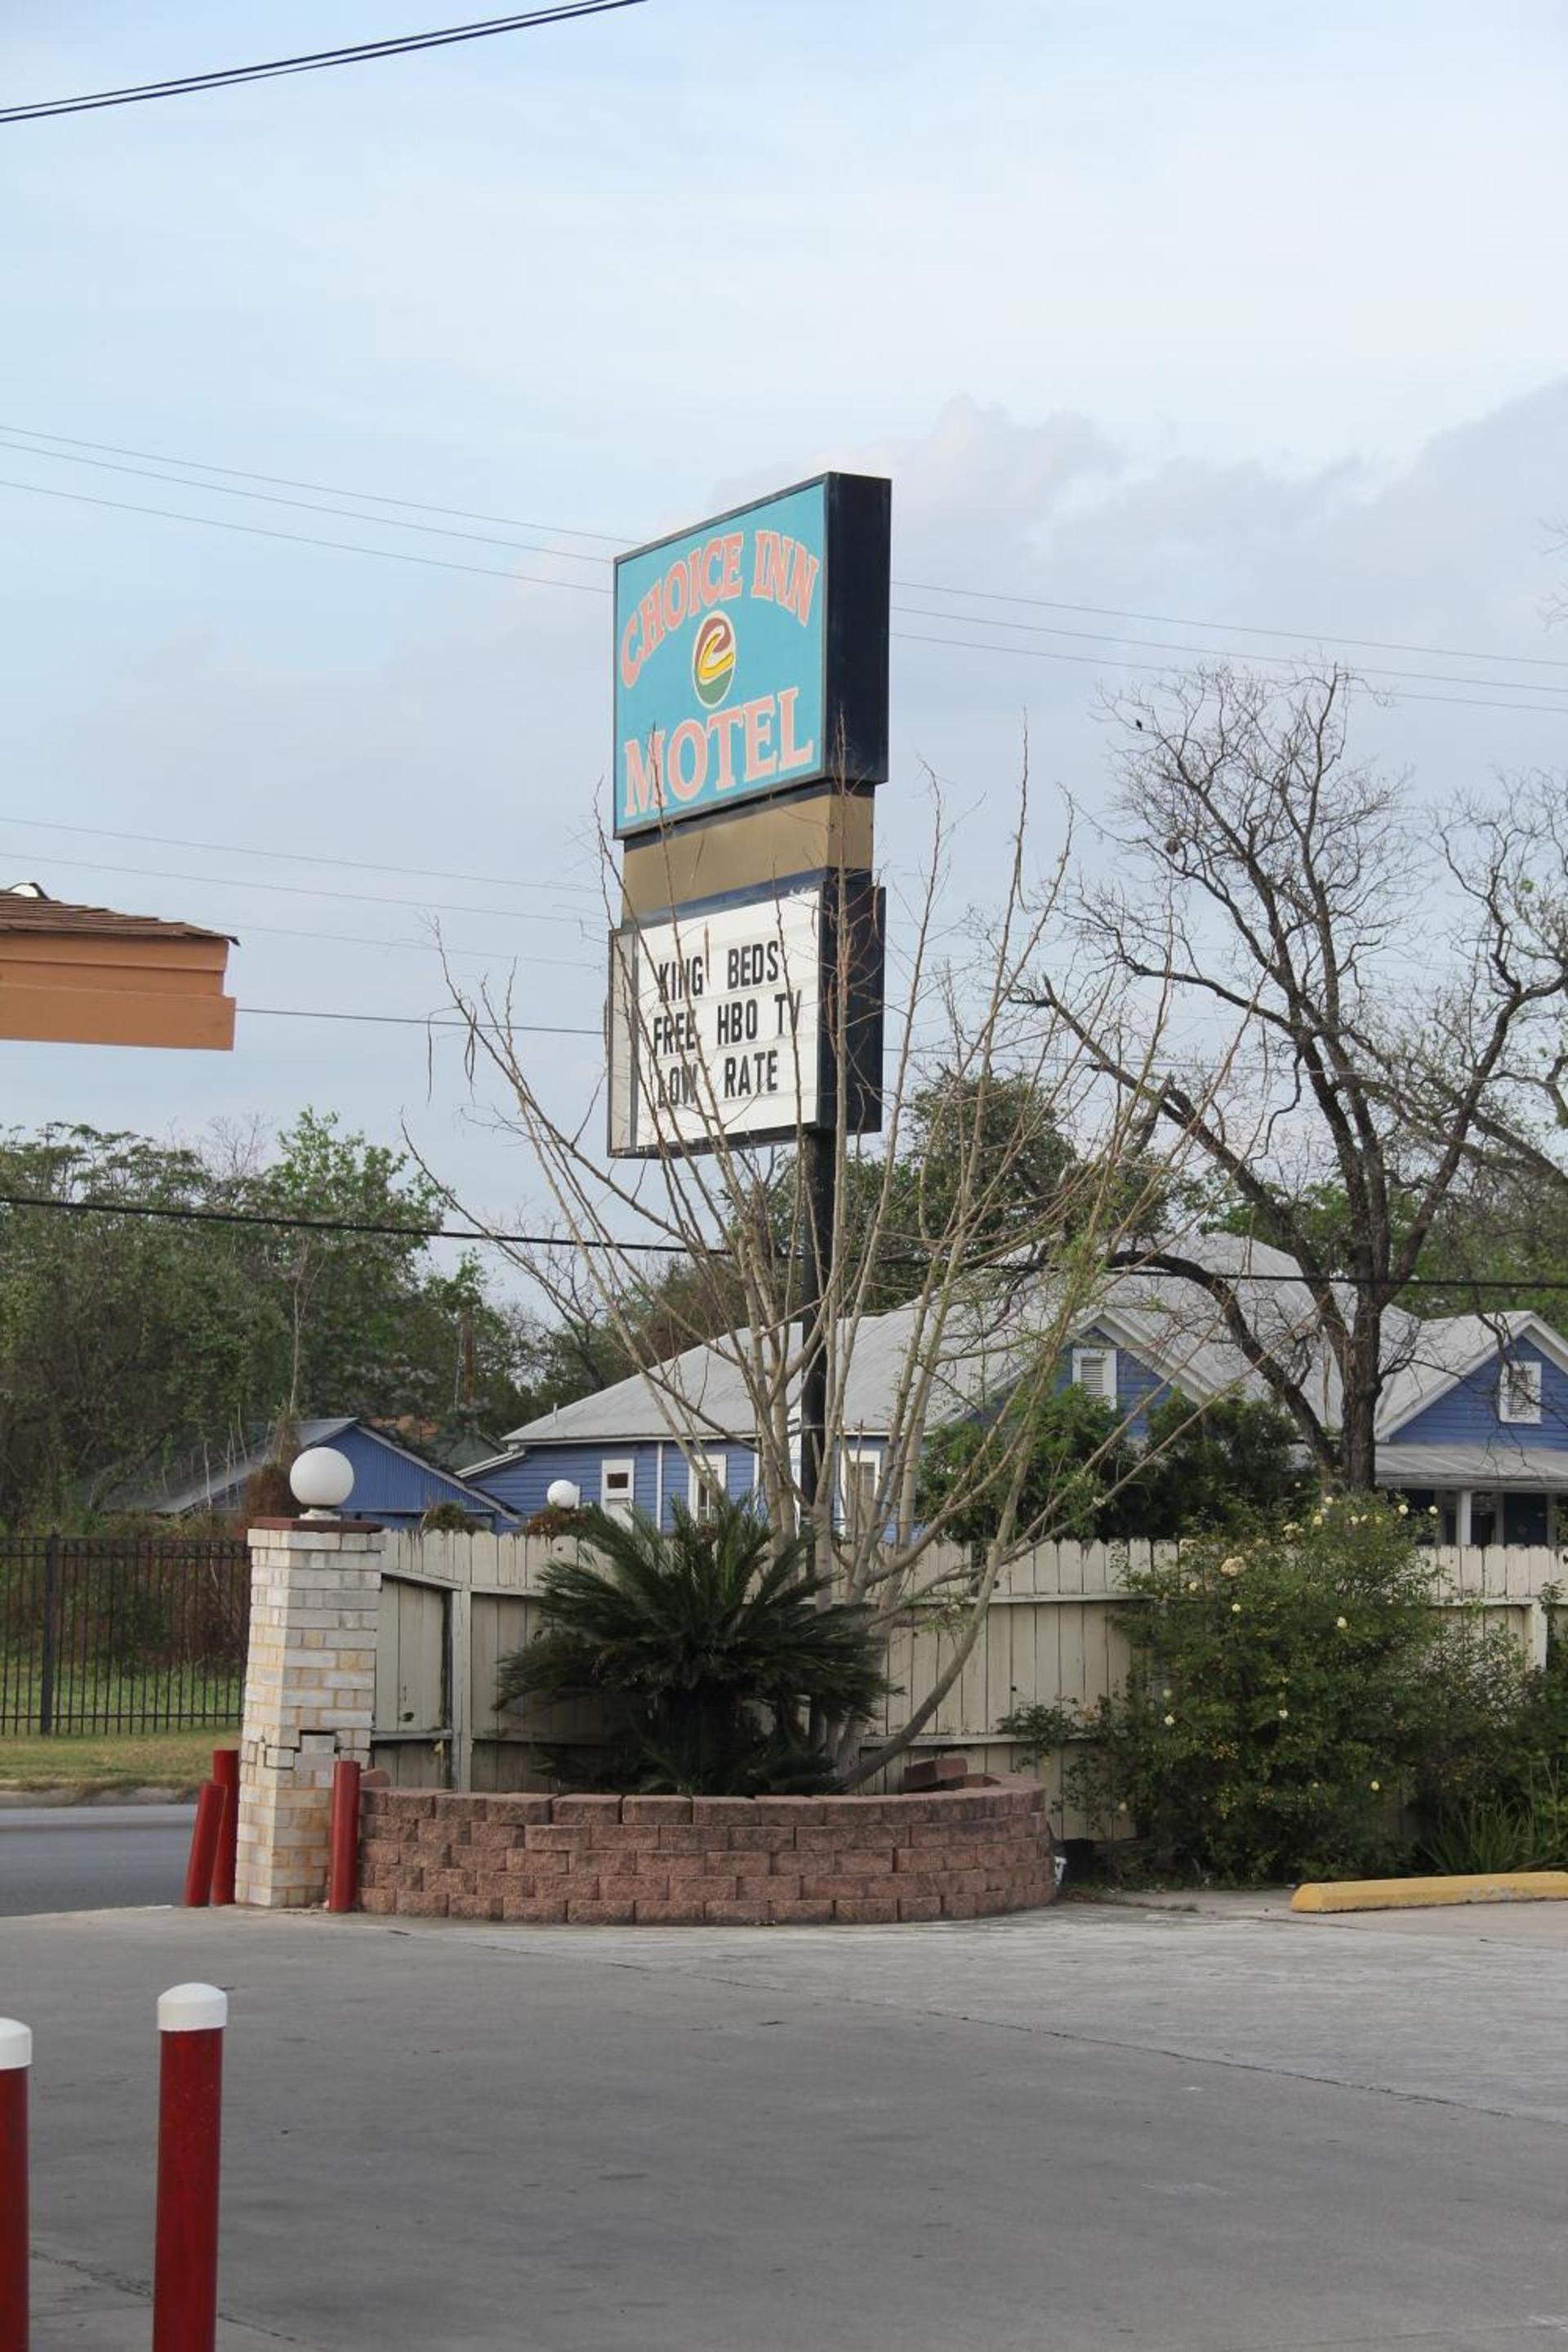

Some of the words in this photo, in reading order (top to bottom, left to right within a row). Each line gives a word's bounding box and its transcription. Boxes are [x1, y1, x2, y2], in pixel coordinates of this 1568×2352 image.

[621, 532, 744, 688] CHOICE
[751, 529, 819, 627] INN
[623, 688, 814, 817] MOTEL
[659, 956, 704, 1003] KING
[728, 940, 779, 990] BEDS
[653, 1009, 697, 1056] FREE
[717, 1000, 759, 1045] HBO
[774, 989, 802, 1035] TV
[658, 1062, 698, 1108] LOW
[724, 1050, 778, 1098] RATE
